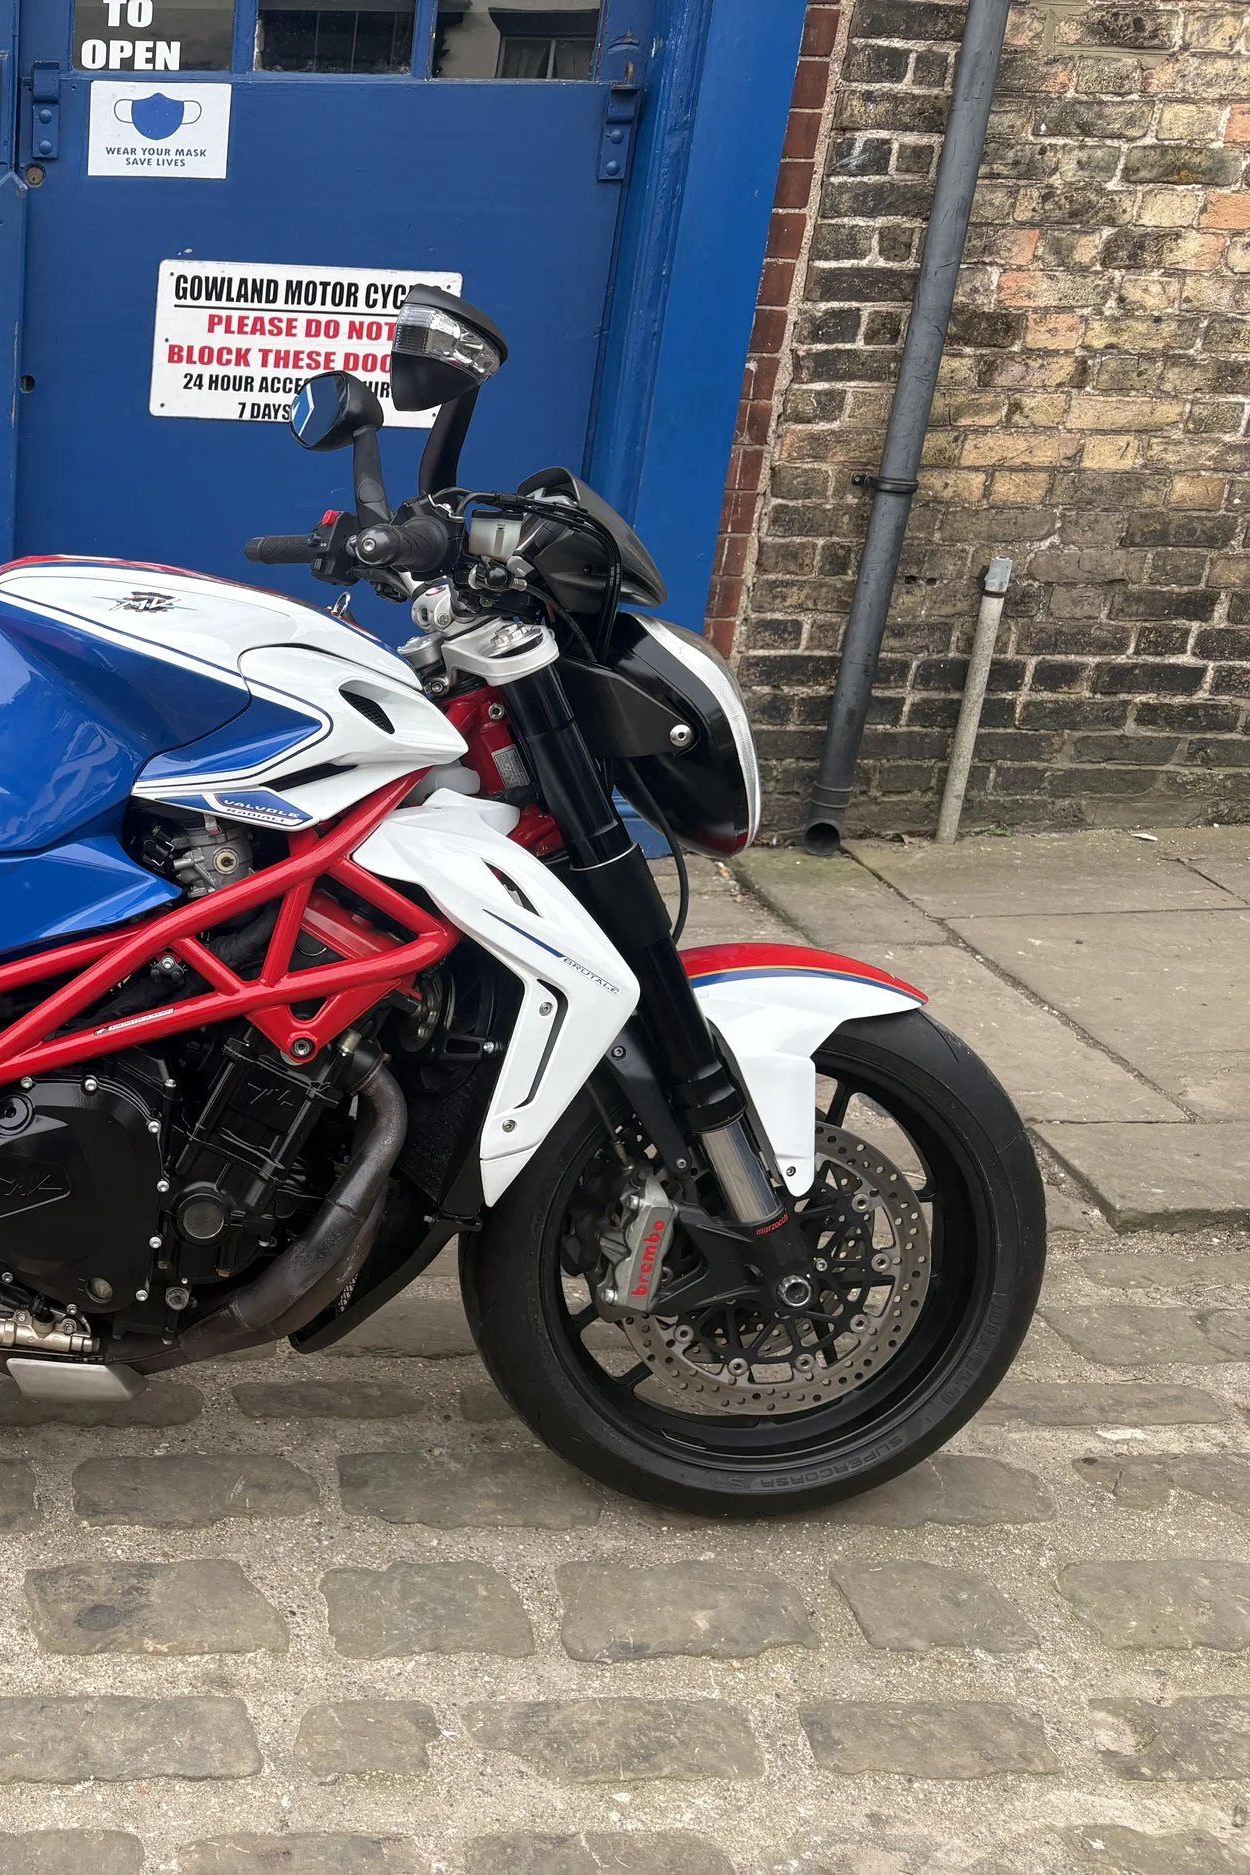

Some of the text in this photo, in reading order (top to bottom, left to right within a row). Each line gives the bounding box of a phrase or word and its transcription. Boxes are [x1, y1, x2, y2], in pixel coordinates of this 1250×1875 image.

[103, 0, 154, 28] TO
[81, 39, 181, 70] OPEN
[106, 146, 207, 157] WEAR YOUR MASK
[125, 157, 186, 167] SAVE LIVES
[174, 274, 413, 310] GOWLAND MOTOR CYC
[207, 313, 396, 342] PLEASE DO NOT
[167, 344, 391, 374] BLOCK THESE DOO
[183, 373, 310, 394] 24 HOUR ACCE
[238, 402, 291, 421] 7 DAYS
[224, 800, 301, 818] VALVOLE
[563, 958, 620, 995] BRUTALE
[756, 1211, 791, 1235] marzocchi
[630, 1220, 666, 1297] brembo
[760, 1435, 903, 1488] SUPERCORSA
